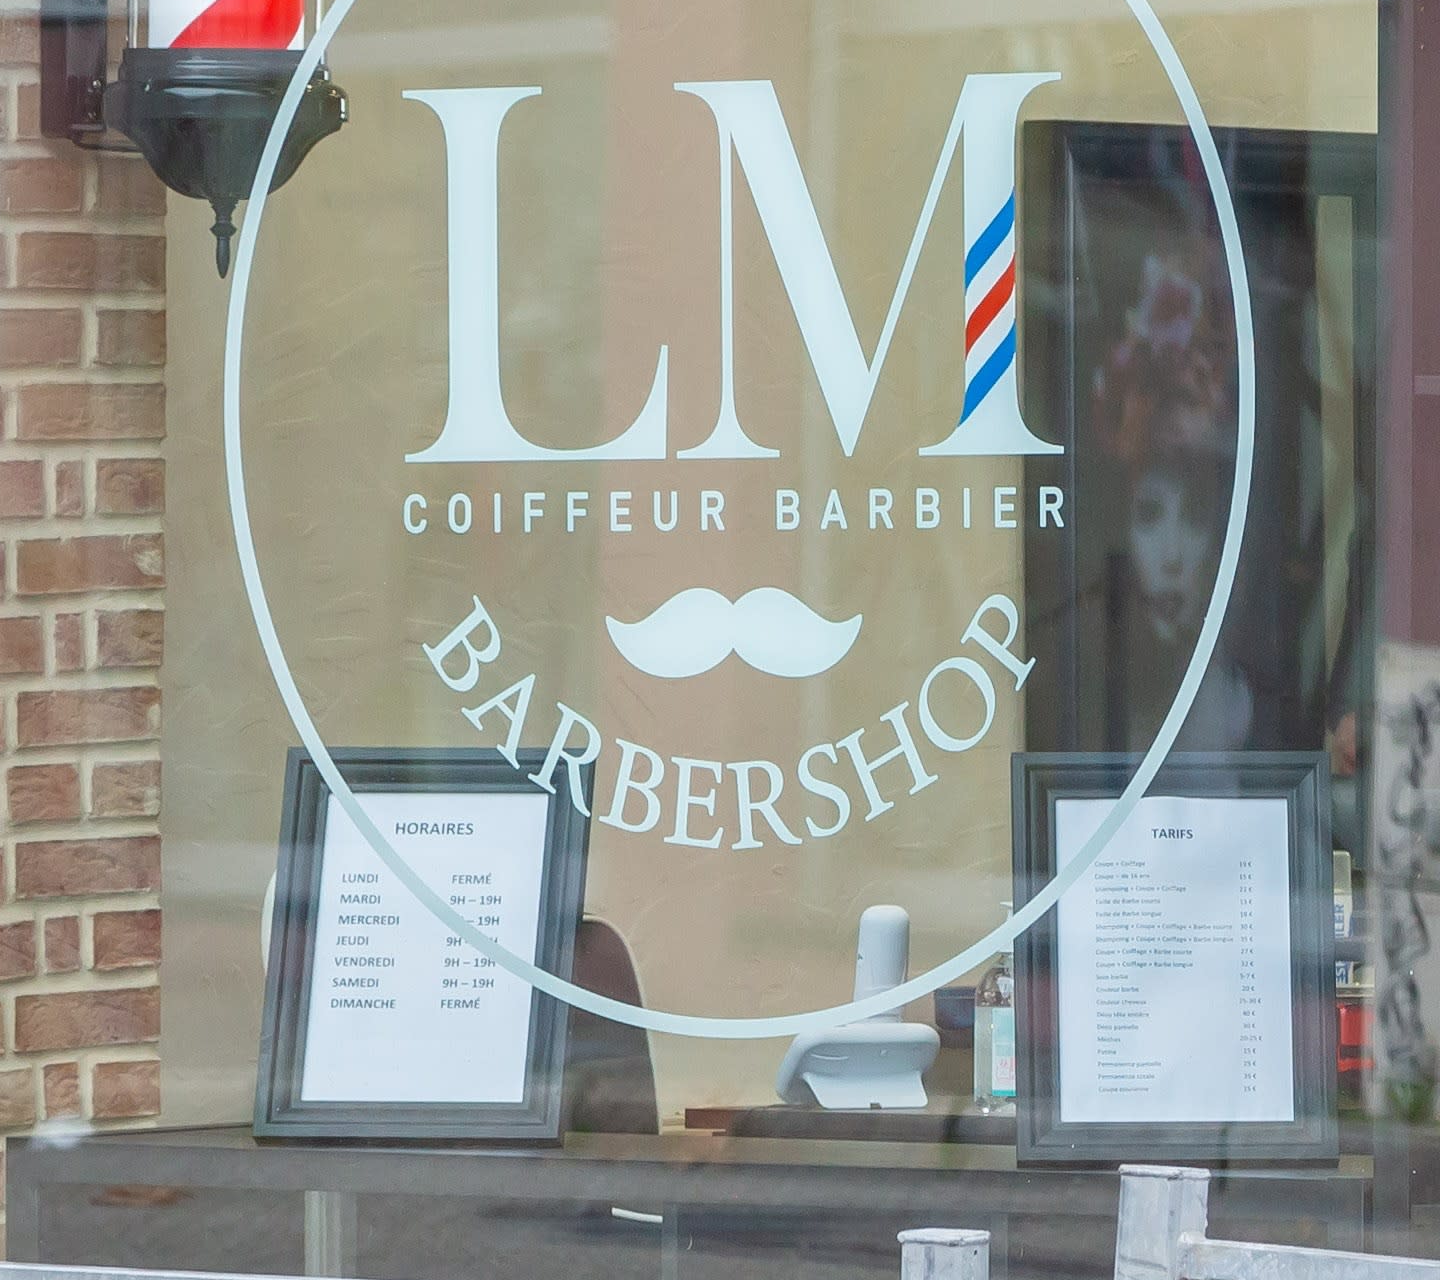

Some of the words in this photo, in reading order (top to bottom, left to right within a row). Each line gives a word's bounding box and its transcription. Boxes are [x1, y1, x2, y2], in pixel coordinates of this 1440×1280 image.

[401, 71, 1065, 463] LM
[403, 488, 727, 536] COIFFEUR
[775, 484, 1066, 532] BARBIER
[421, 592, 1037, 852] BARBERSHOP
[395, 823, 474, 836] HORAIRES
[1152, 829, 1193, 839] TARIFS
[342, 874, 378, 884] LUNDI
[451, 873, 492, 885] FERMÉ
[340, 894, 381, 905] MARDI
[450, 895, 466, 905] 9H
[480, 895, 501, 905] 19H
[338, 915, 400, 926] MERCREDI
[477, 916, 500, 926] 19H
[336, 936, 369, 946] JEUDI
[446, 937, 462, 947] 9H
[334, 957, 395, 967] VENDREDI
[444, 958, 460, 967] 9H
[474, 958, 496, 967] 19H
[332, 978, 378, 988] SAMEDI
[442, 979, 458, 988] 9H
[473, 979, 494, 988] 19H
[330, 999, 396, 1009] DIMANCHE
[440, 998, 480, 1010] FERMÉ
